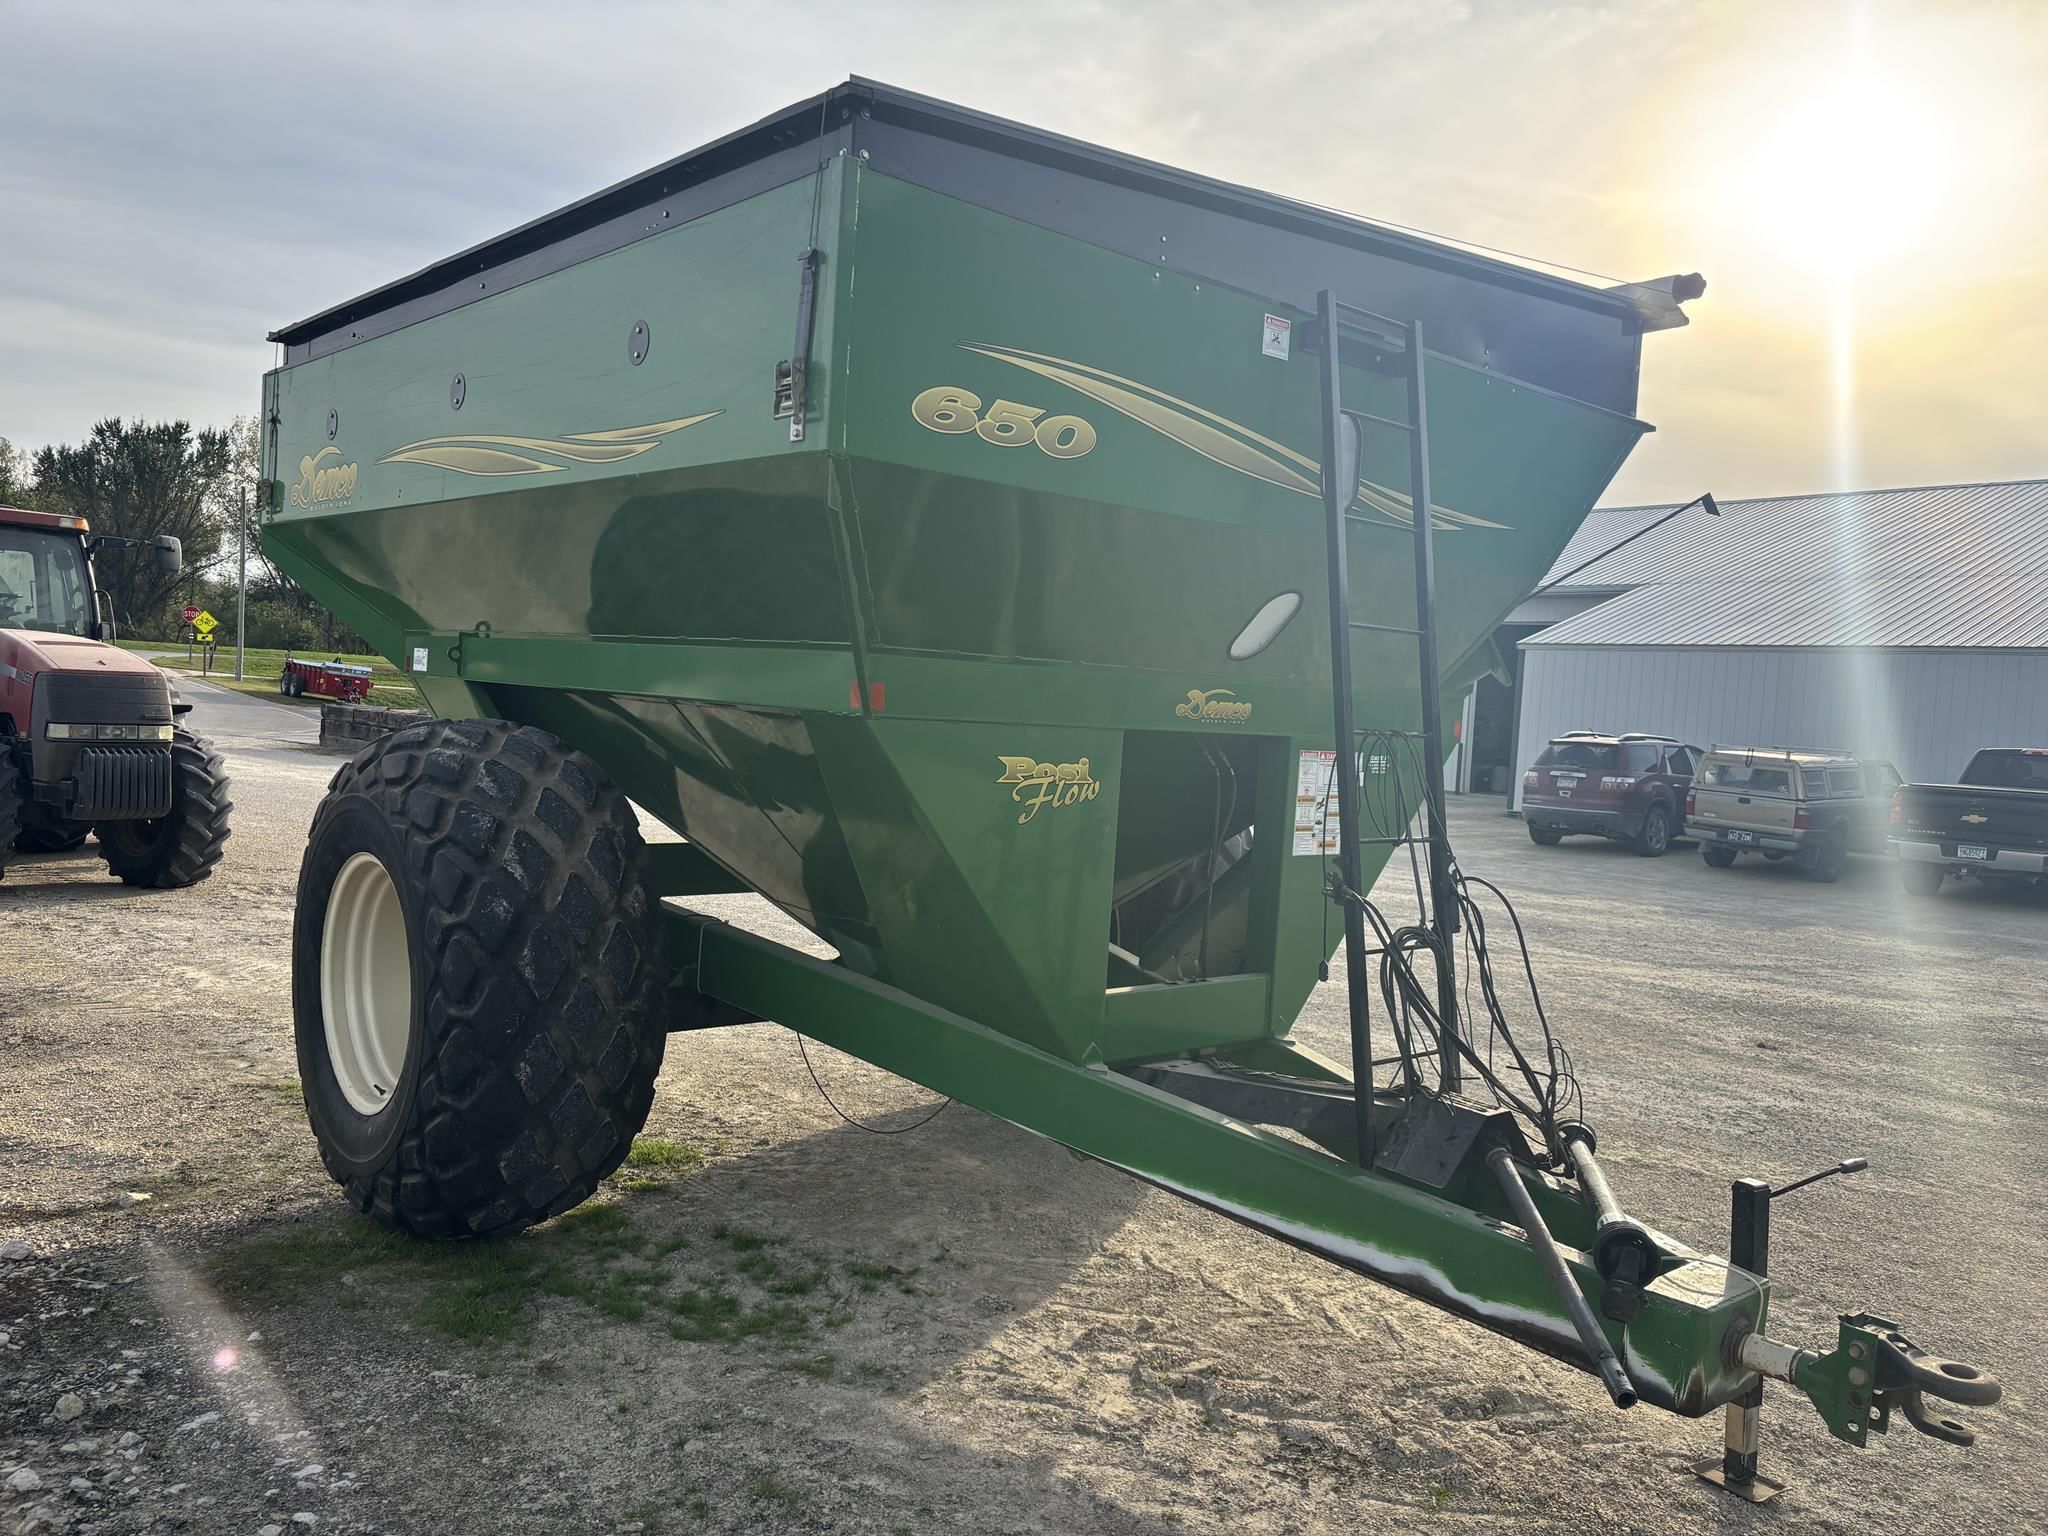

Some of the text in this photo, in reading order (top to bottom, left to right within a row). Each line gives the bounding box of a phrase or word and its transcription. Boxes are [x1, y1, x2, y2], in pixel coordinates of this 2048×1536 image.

[911, 385, 1097, 460] 650
[290, 445, 358, 509] Demco
[1175, 688, 1252, 720] Demco
[995, 755, 1095, 784] Posi
[1012, 776, 1101, 825] Flow
